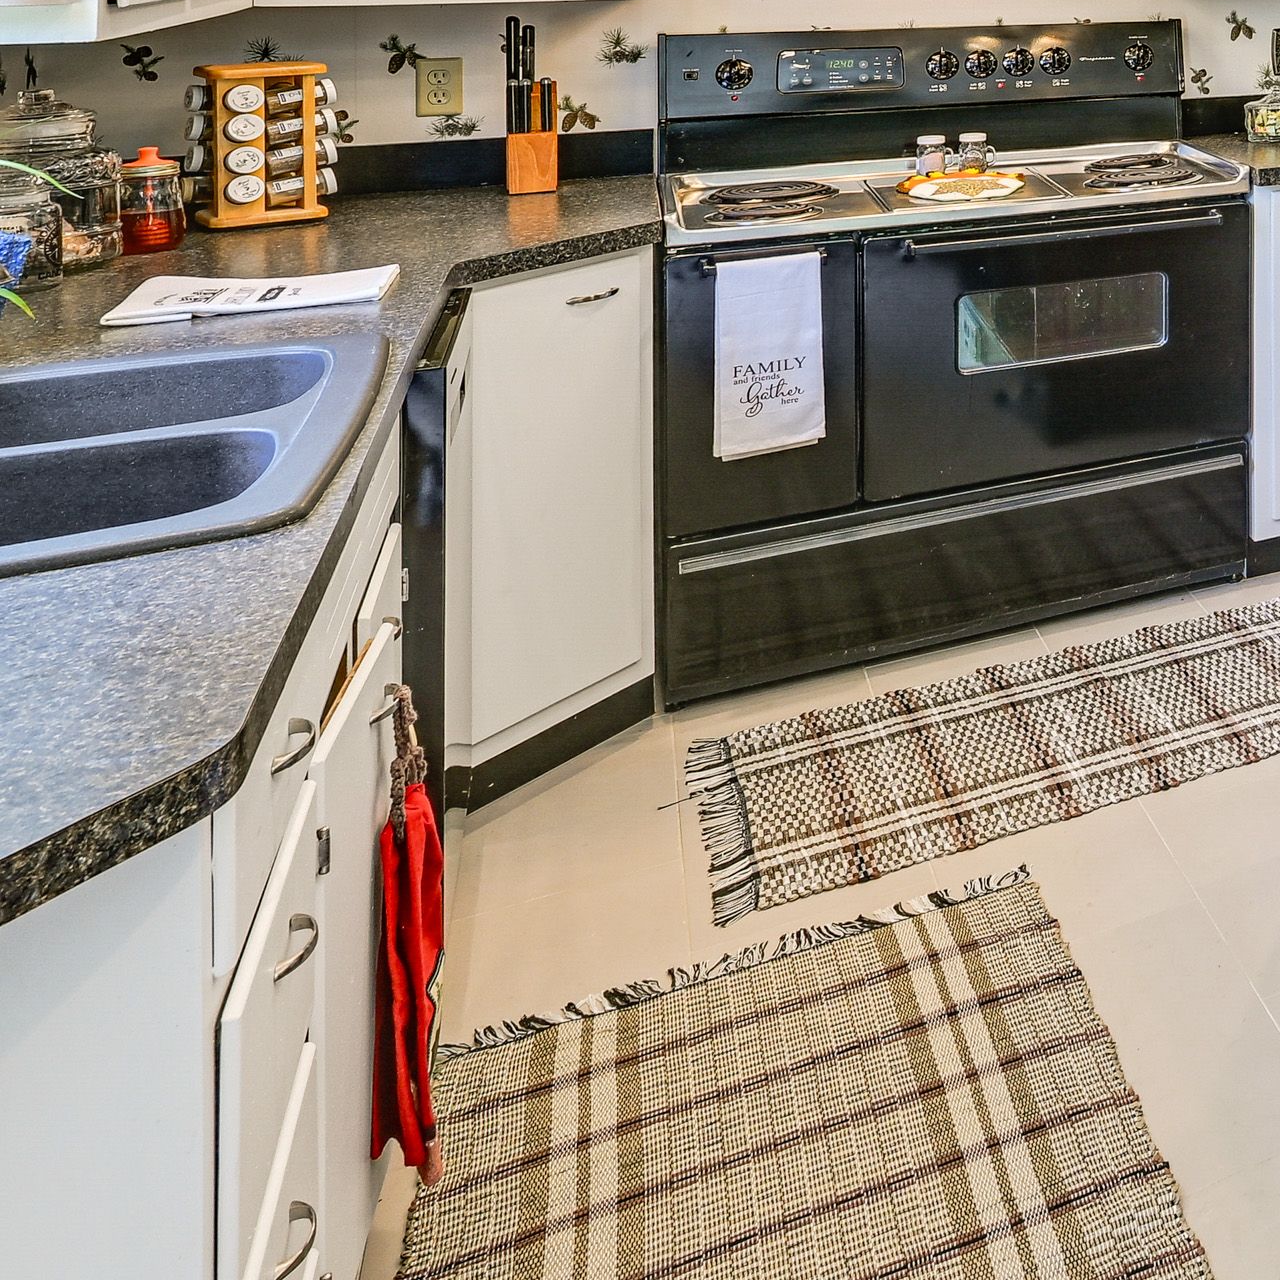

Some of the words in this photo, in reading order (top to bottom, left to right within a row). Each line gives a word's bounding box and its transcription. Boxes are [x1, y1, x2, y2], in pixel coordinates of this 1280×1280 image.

[733, 356, 807, 379] FAMILY
[733, 376, 749, 386] and
[751, 372, 781, 383] friends
[739, 378, 805, 418] Gather
[781, 397, 800, 406] here
